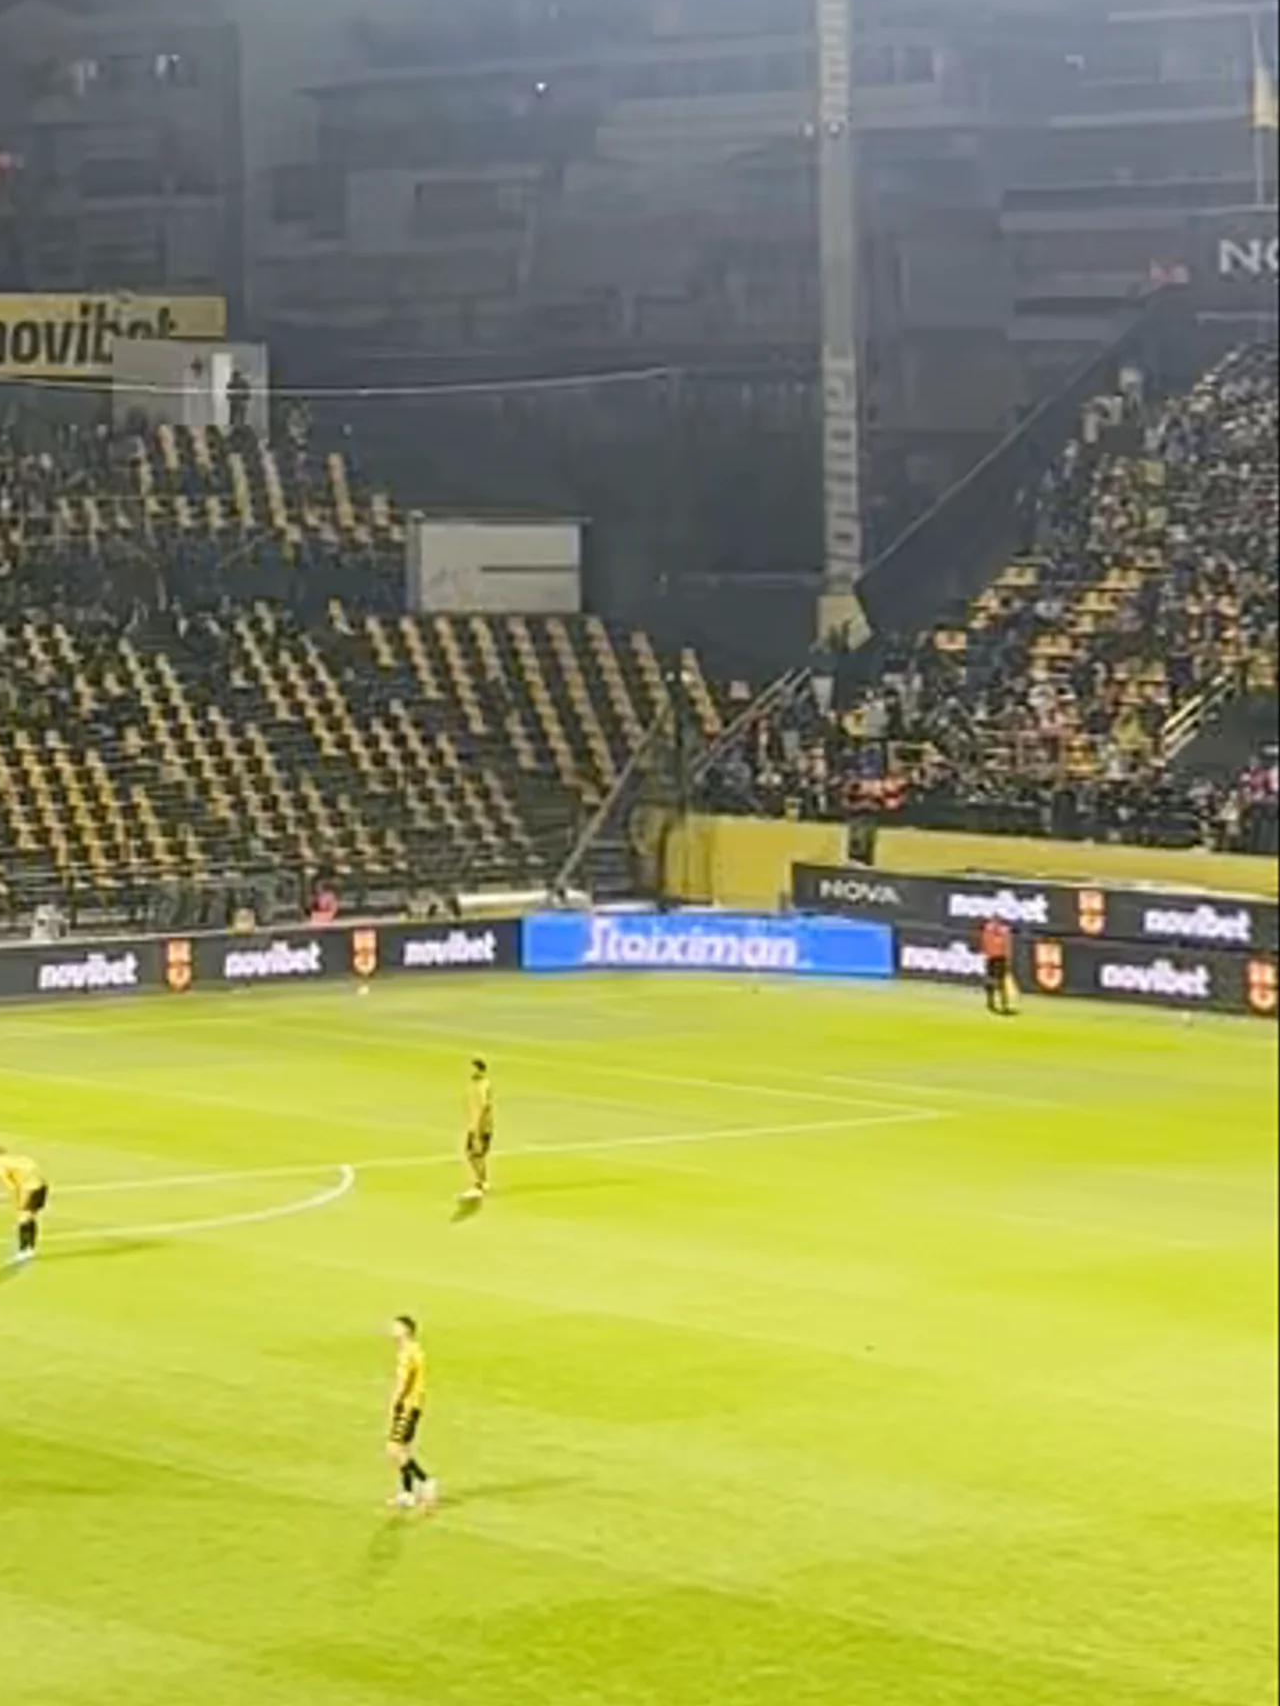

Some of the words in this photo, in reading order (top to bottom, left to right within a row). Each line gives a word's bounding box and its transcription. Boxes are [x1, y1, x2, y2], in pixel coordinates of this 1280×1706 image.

[1219, 237, 1278, 274] N
[819, 879, 900, 906] NOVA
[949, 891, 1049, 924] novibet
[1144, 905, 1251, 942] novibet
[40, 952, 137, 988] novibet
[225, 940, 321, 978] novibet
[403, 931, 497, 966] novibet
[585, 918, 797, 968] Stoiximan
[1099, 960, 1211, 998] novibet
